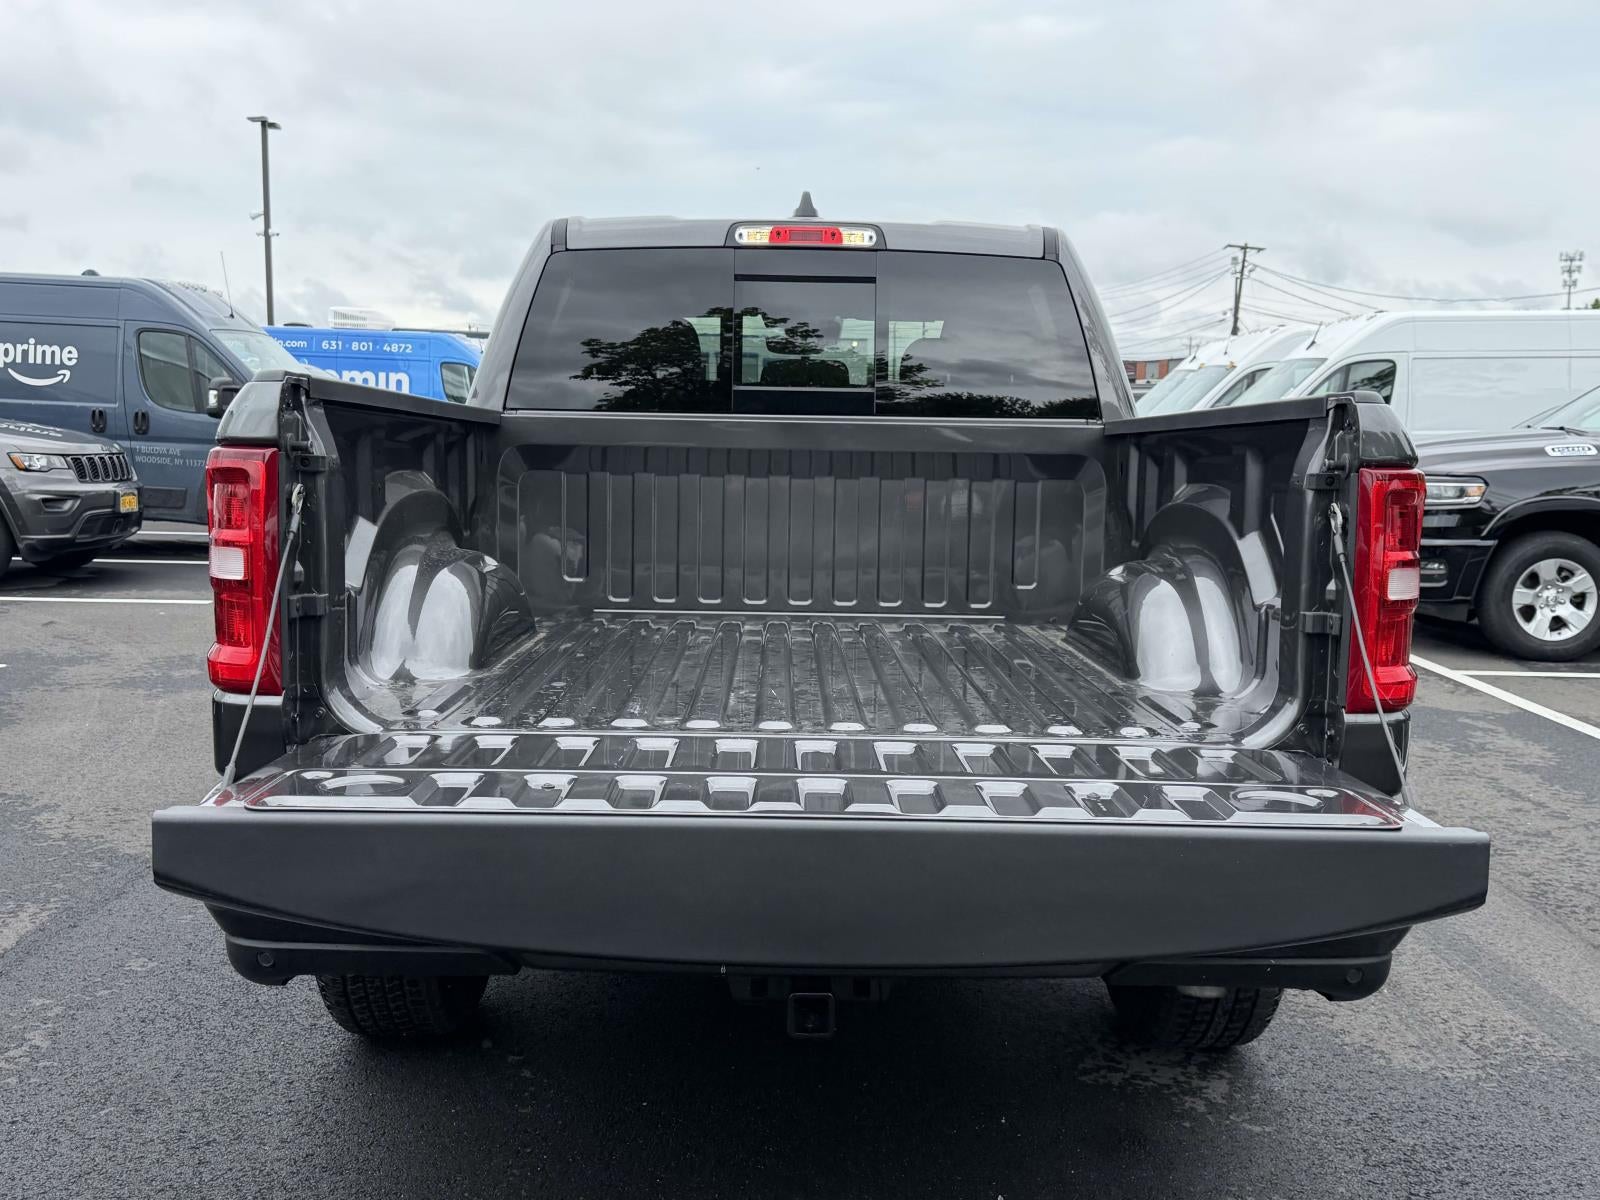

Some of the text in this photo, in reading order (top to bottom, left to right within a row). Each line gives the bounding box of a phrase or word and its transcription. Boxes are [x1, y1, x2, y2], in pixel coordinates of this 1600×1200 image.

[0, 338, 79, 368] prime
[321, 340, 343, 350] 631
[351, 342, 373, 351] 801
[383, 343, 413, 353] 4872
